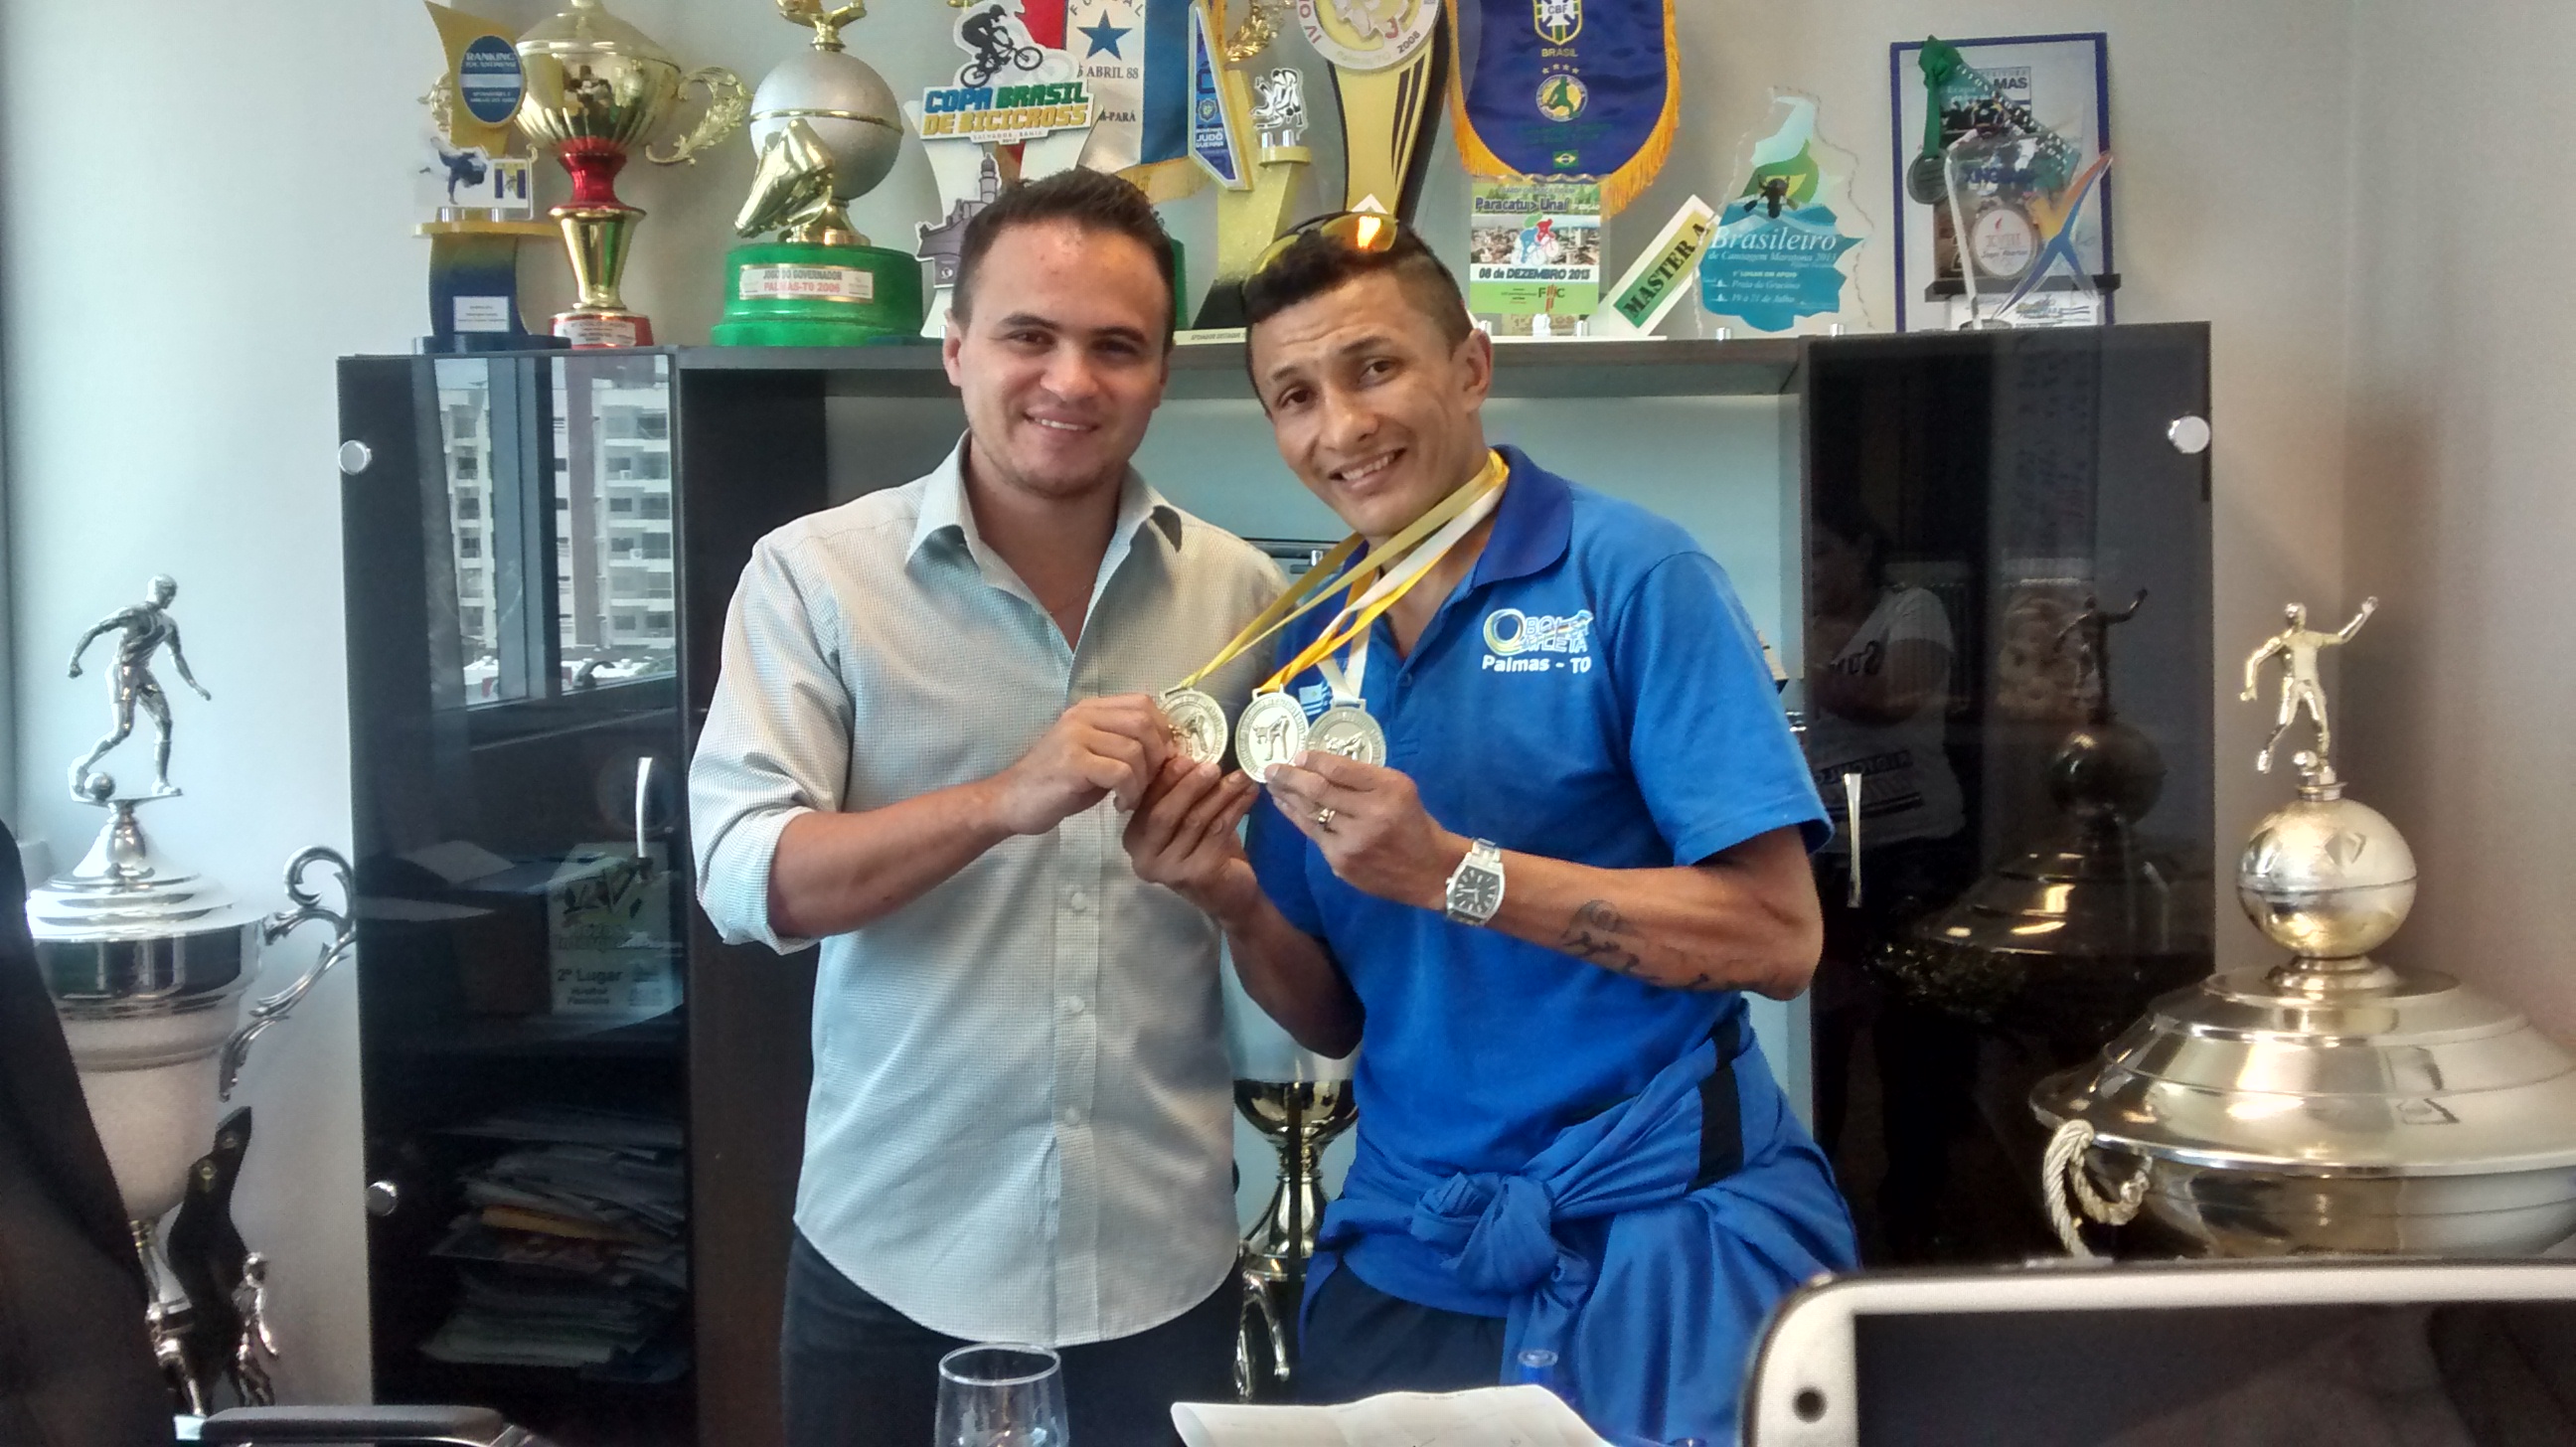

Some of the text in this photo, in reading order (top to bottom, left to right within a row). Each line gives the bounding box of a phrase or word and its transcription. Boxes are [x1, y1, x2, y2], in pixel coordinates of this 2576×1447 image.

[1547, 4, 1568, 14] CBF
[1396, 30, 1421, 54] 2008
[465, 52, 516, 61] RANKING
[1541, 48, 1578, 58] BRASIL
[1086, 65, 1123, 79] ABRIL
[1126, 67, 1139, 79] 88
[924, 81, 1089, 113] COPA BRASIL
[921, 104, 1088, 135] DE BICICROSS
[1475, 197, 1527, 212] Paracatu
[1711, 227, 1837, 250] Brasileiro
[1707, 250, 1719, 260] de
[793, 269, 843, 280] GOVERNADOR
[1479, 268, 1492, 279] 08
[1494, 267, 1505, 279] de
[1506, 268, 1566, 280] DEZEMBRO
[1624, 224, 1710, 318] MASTER A
[1482, 654, 1550, 673] Palmas
[1570, 656, 1592, 674] TO
[575, 968, 624, 985] Lugar
